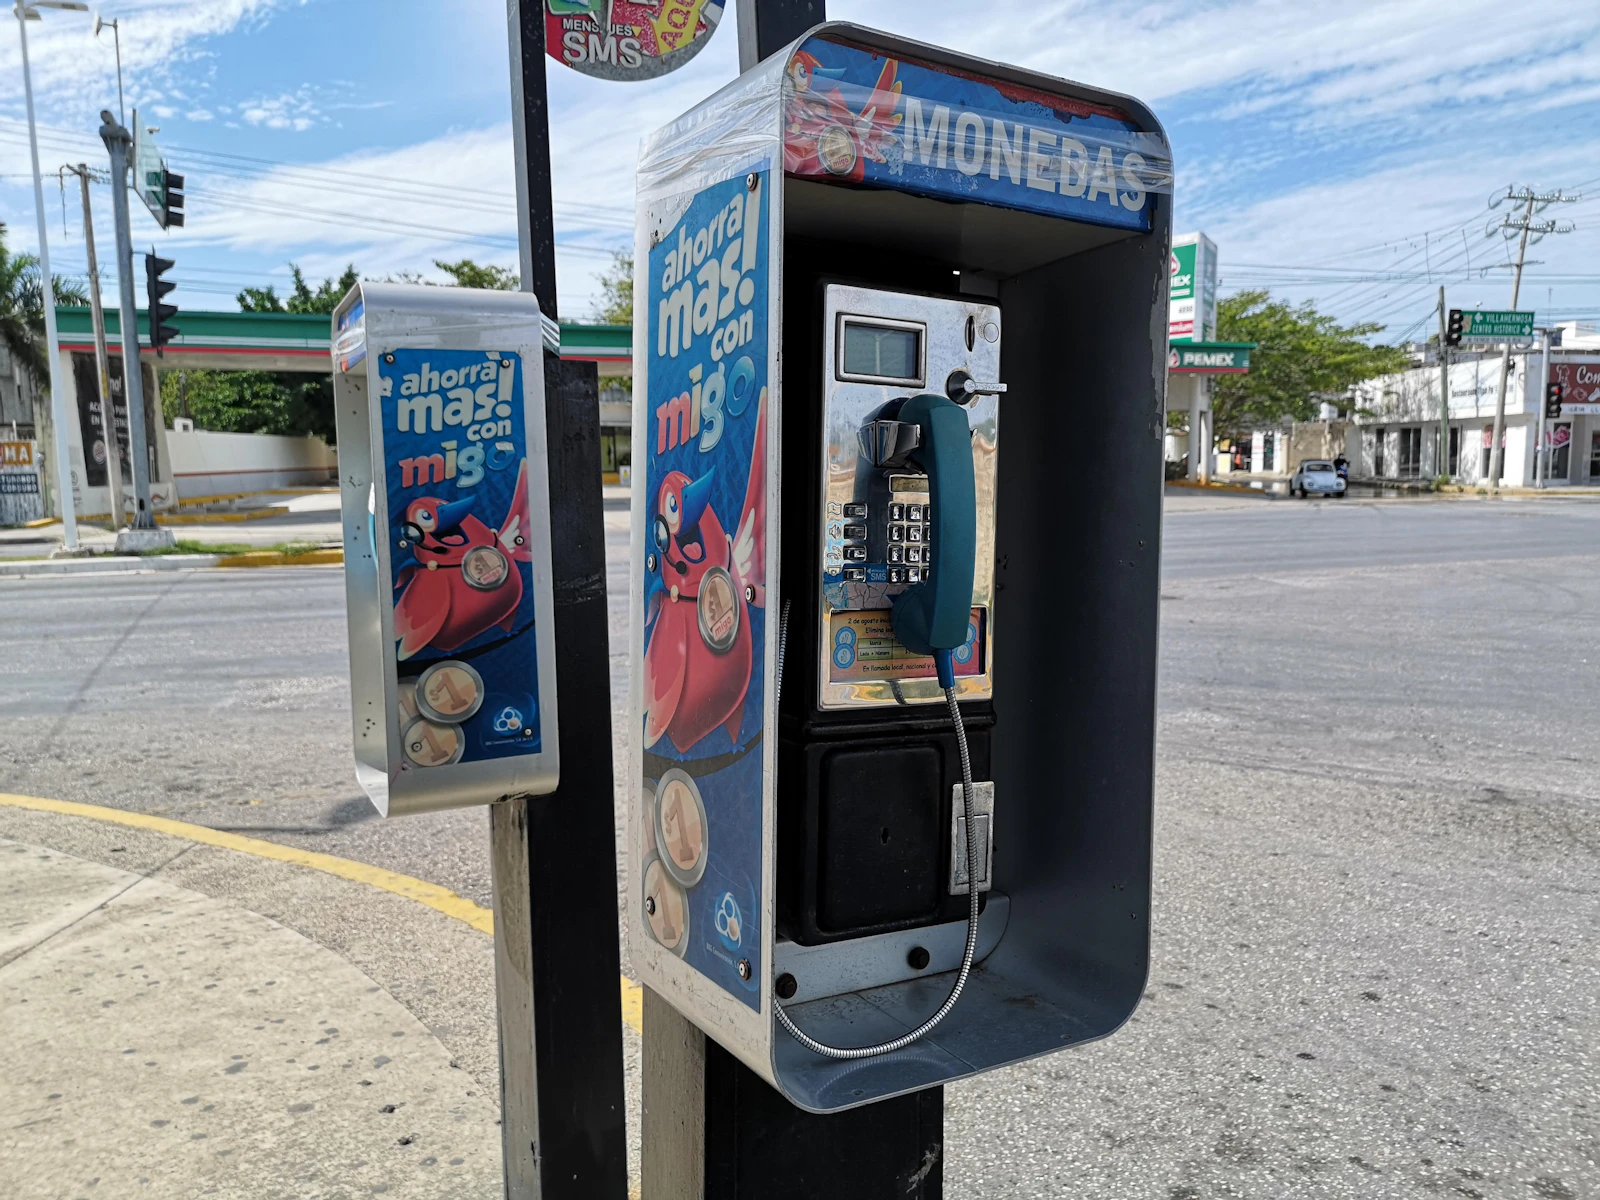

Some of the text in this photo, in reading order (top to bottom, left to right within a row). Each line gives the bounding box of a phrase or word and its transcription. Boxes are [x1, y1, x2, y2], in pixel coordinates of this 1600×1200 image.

[562, 18, 633, 36] MENSJES
[562, 31, 642, 68] SMS
[902, 97, 1147, 212] MONEDAS
[662, 193, 743, 292] ahorra
[1472, 324, 1492, 334] CENTRO
[1485, 313, 1532, 324] VILLAHERMOSA
[711, 309, 753, 362] con
[1183, 352, 1235, 366] PEMEX
[400, 362, 498, 396] ahorra
[656, 356, 755, 455] migo
[466, 419, 512, 441] con
[398, 440, 516, 488] migo
[870, 573, 887, 581] SMS
[714, 616, 732, 636] migo
